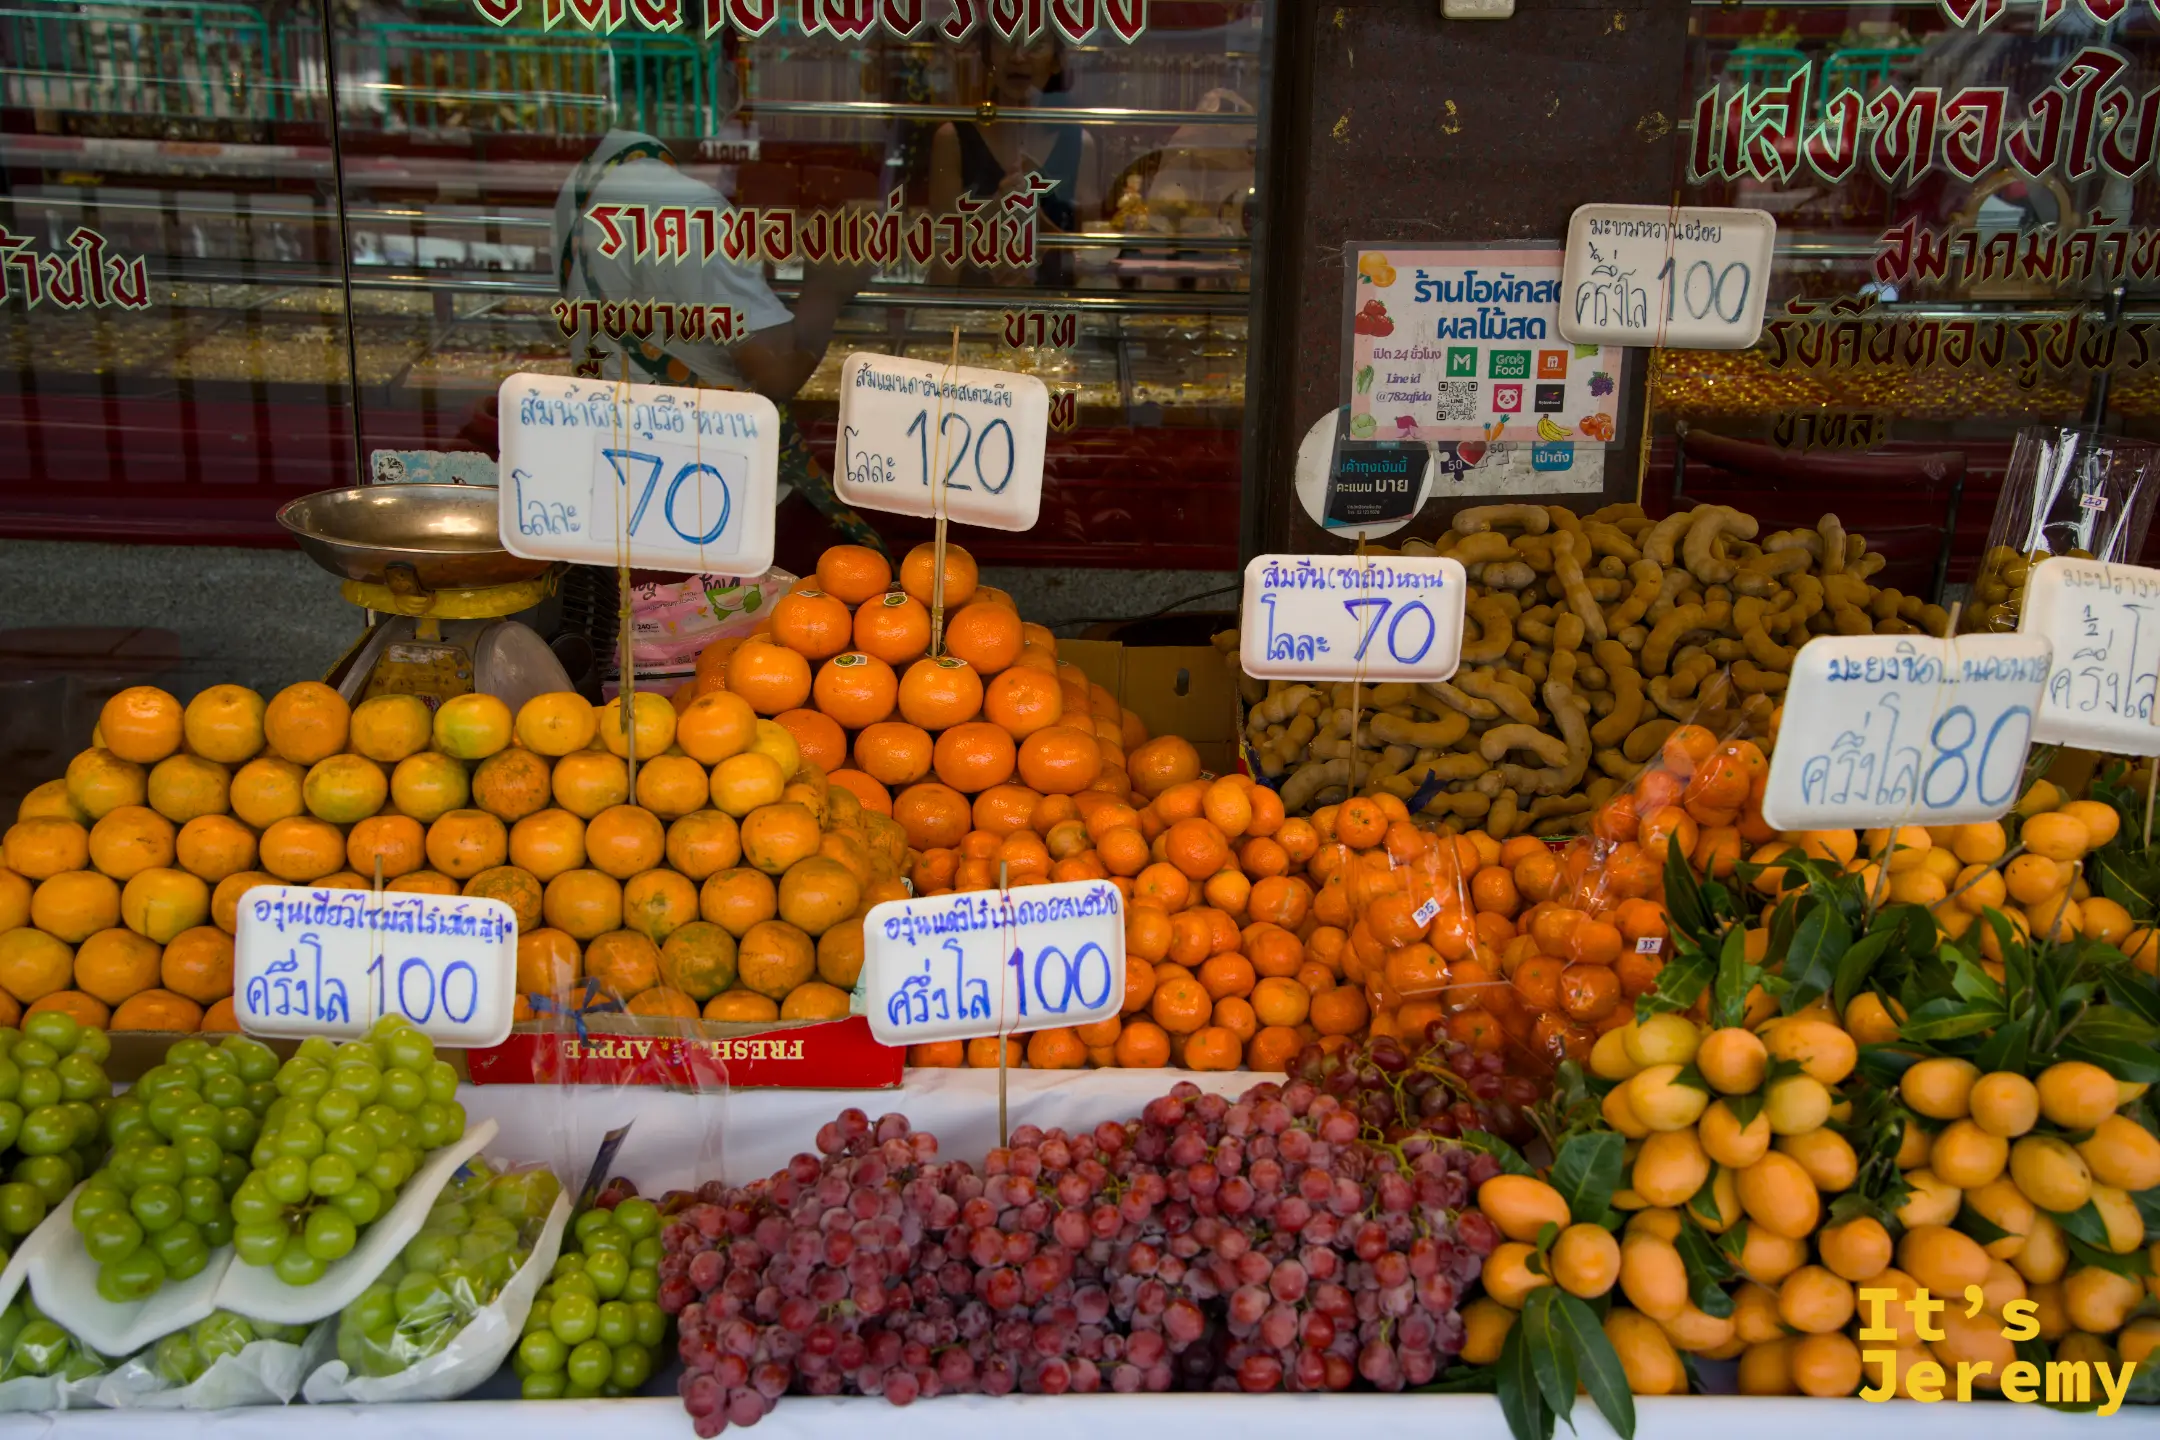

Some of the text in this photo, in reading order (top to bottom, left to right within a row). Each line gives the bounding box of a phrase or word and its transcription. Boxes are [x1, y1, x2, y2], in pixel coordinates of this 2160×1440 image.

[1687, 46, 2160, 188] แสงทองใบ
[584, 170, 1062, 270] ราคาทองแท่งวันนี้
[0, 224, 152, 311] ้านใน
[1657, 256, 1752, 325] 100
[551, 296, 750, 346] ขายบาทละ
[1002, 307, 1080, 350] บาท
[1437, 307, 1547, 340] ผลไม้สด
[1764, 291, 2160, 391] รับคืนทองรูปพร
[1385, 372, 1421, 385] Line id
[1393, 349, 1408, 361] 24
[1495, 354, 1526, 365] Grab
[1495, 365, 1525, 376] Food
[906, 409, 1014, 495] 120
[1448, 460, 1463, 471] 50
[1490, 442, 1504, 454] 50
[601, 448, 731, 546] 70
[1343, 597, 1436, 665] 70
[1922, 704, 2033, 809] 80
[366, 953, 478, 1025] 100
[1008, 941, 1112, 1017] 100
[561, 1039, 654, 1060] APPLE
[710, 1039, 805, 1060] FRESH
